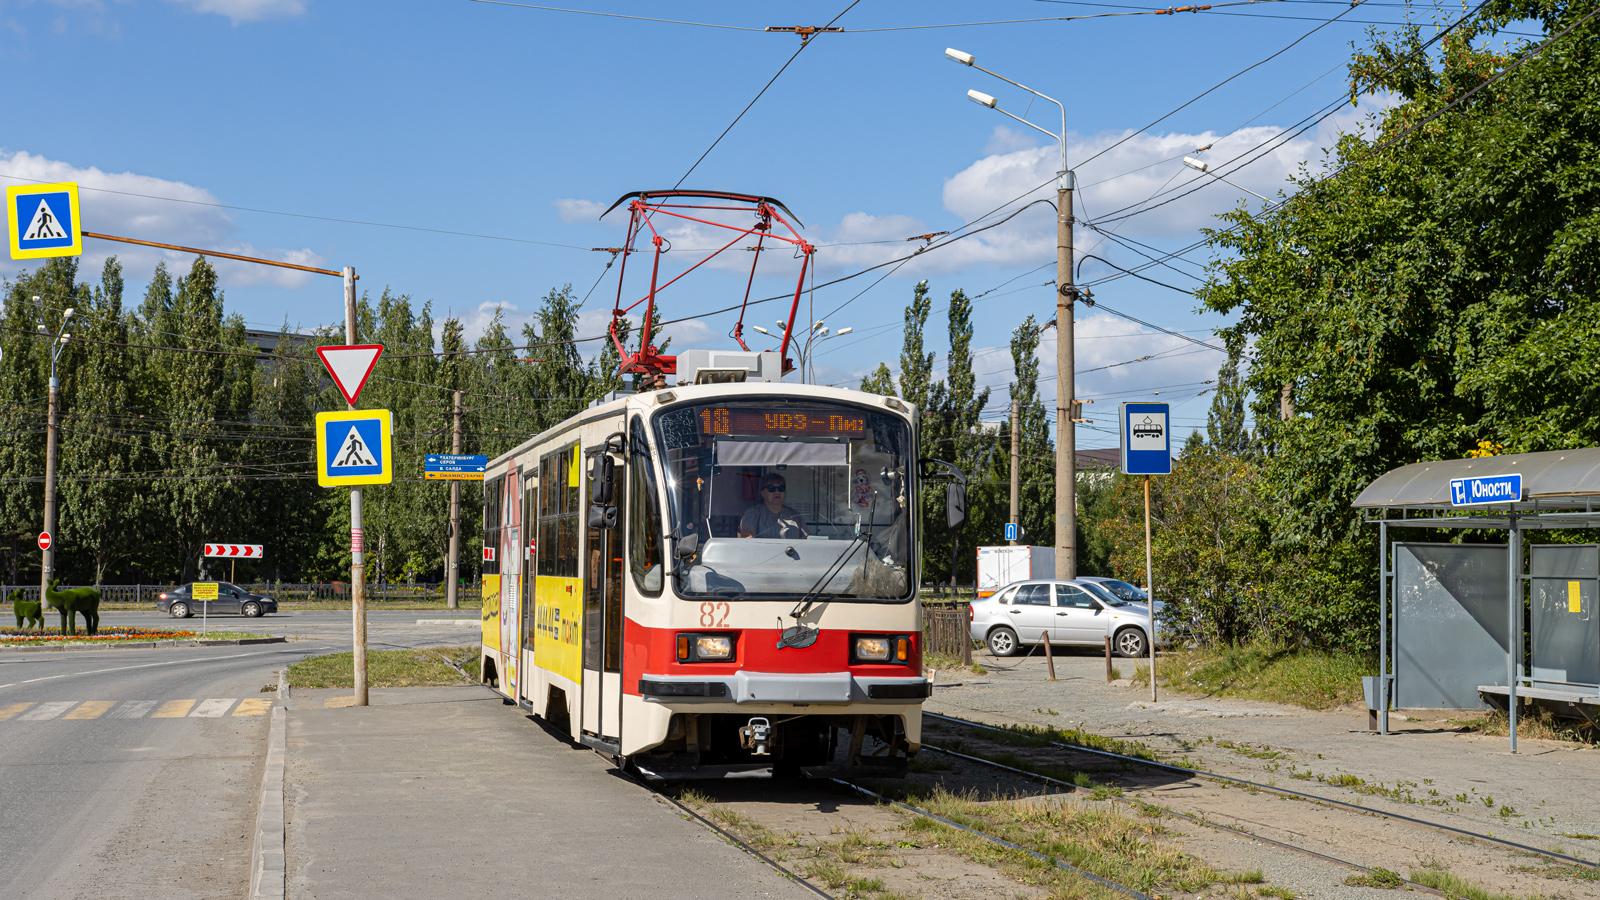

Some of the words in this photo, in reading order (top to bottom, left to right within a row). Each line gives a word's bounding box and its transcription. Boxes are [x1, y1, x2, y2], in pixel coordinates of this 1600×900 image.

[765, 413, 807, 430] УВЗ
[1471, 479, 1512, 498] Юности
[700, 602, 730, 628] 82
